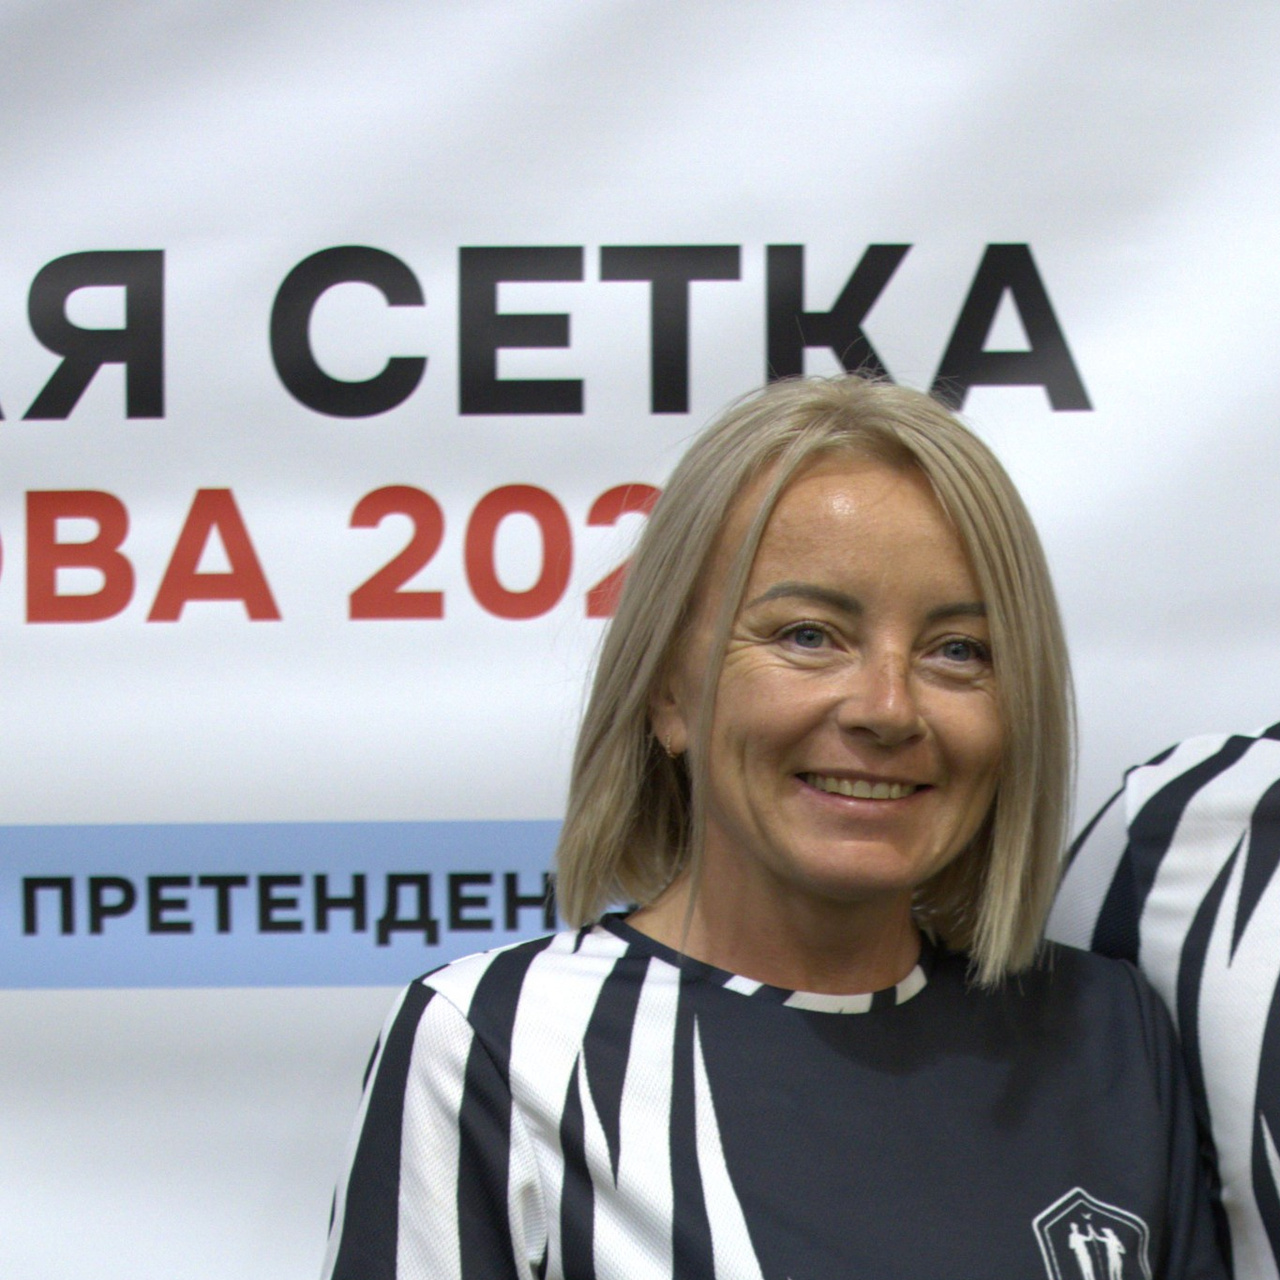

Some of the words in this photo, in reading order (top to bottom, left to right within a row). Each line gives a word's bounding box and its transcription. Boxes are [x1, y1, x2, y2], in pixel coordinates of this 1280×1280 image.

[0, 248, 166, 421] Я
[268, 242, 1095, 418] СЕТКА
[0, 486, 283, 624] ВА
[22, 872, 557, 947] ПРЕТЕНДЕН
